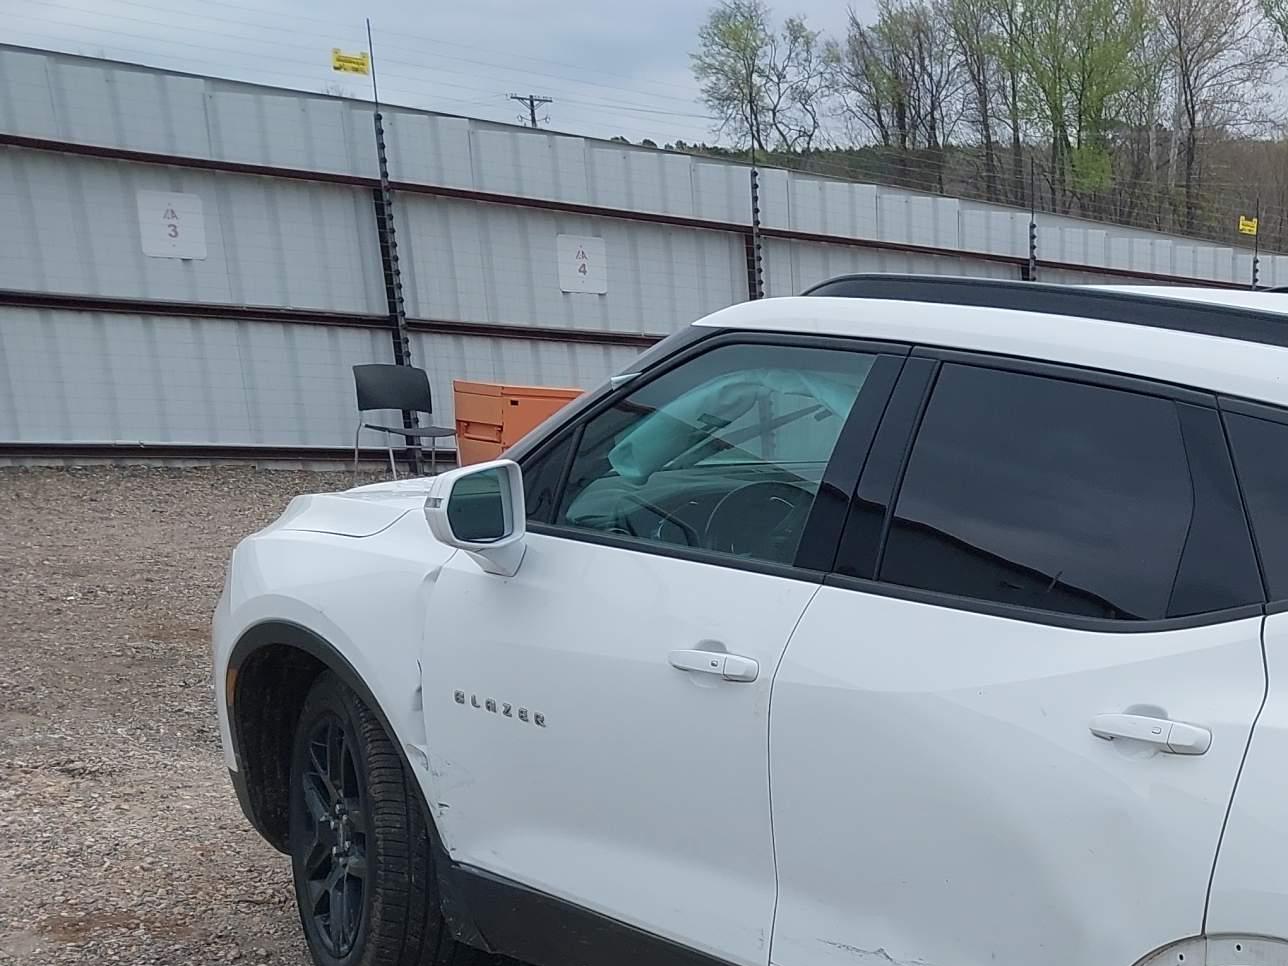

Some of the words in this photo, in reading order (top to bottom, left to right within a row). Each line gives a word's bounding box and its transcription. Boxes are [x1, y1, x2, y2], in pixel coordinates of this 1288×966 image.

[168, 223, 179, 238] 3
[578, 263, 588, 276] 4
[454, 690, 546, 728] BLAZER
